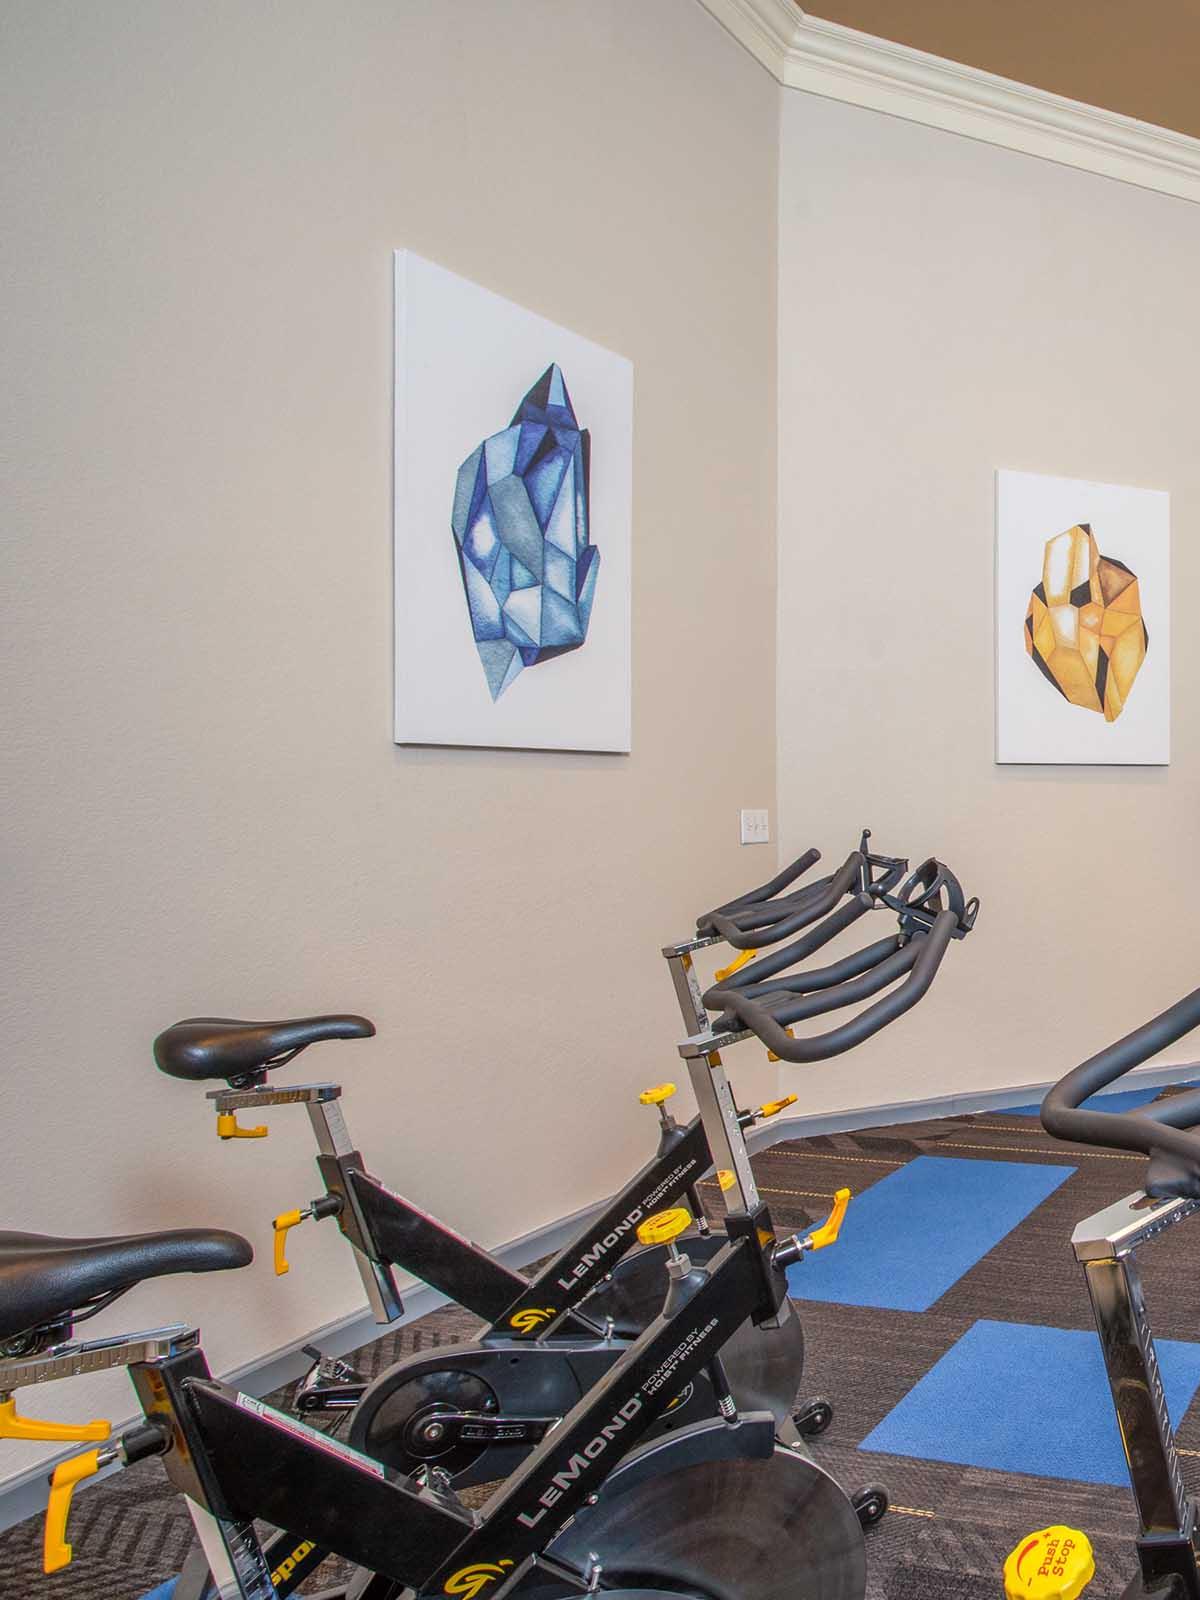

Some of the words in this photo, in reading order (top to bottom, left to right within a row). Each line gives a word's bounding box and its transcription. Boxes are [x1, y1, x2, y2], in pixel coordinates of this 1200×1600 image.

[642, 1174, 674, 1206] POWERED
[672, 1163, 685, 1176] BY
[668, 1159, 697, 1188] FITNESS
[642, 1343, 688, 1392] POWERED
[685, 1327, 701, 1344] BY
[680, 1318, 719, 1361] FITNESS
[1038, 1539, 1060, 1577] Push
[1052, 1539, 1075, 1577] Stop
